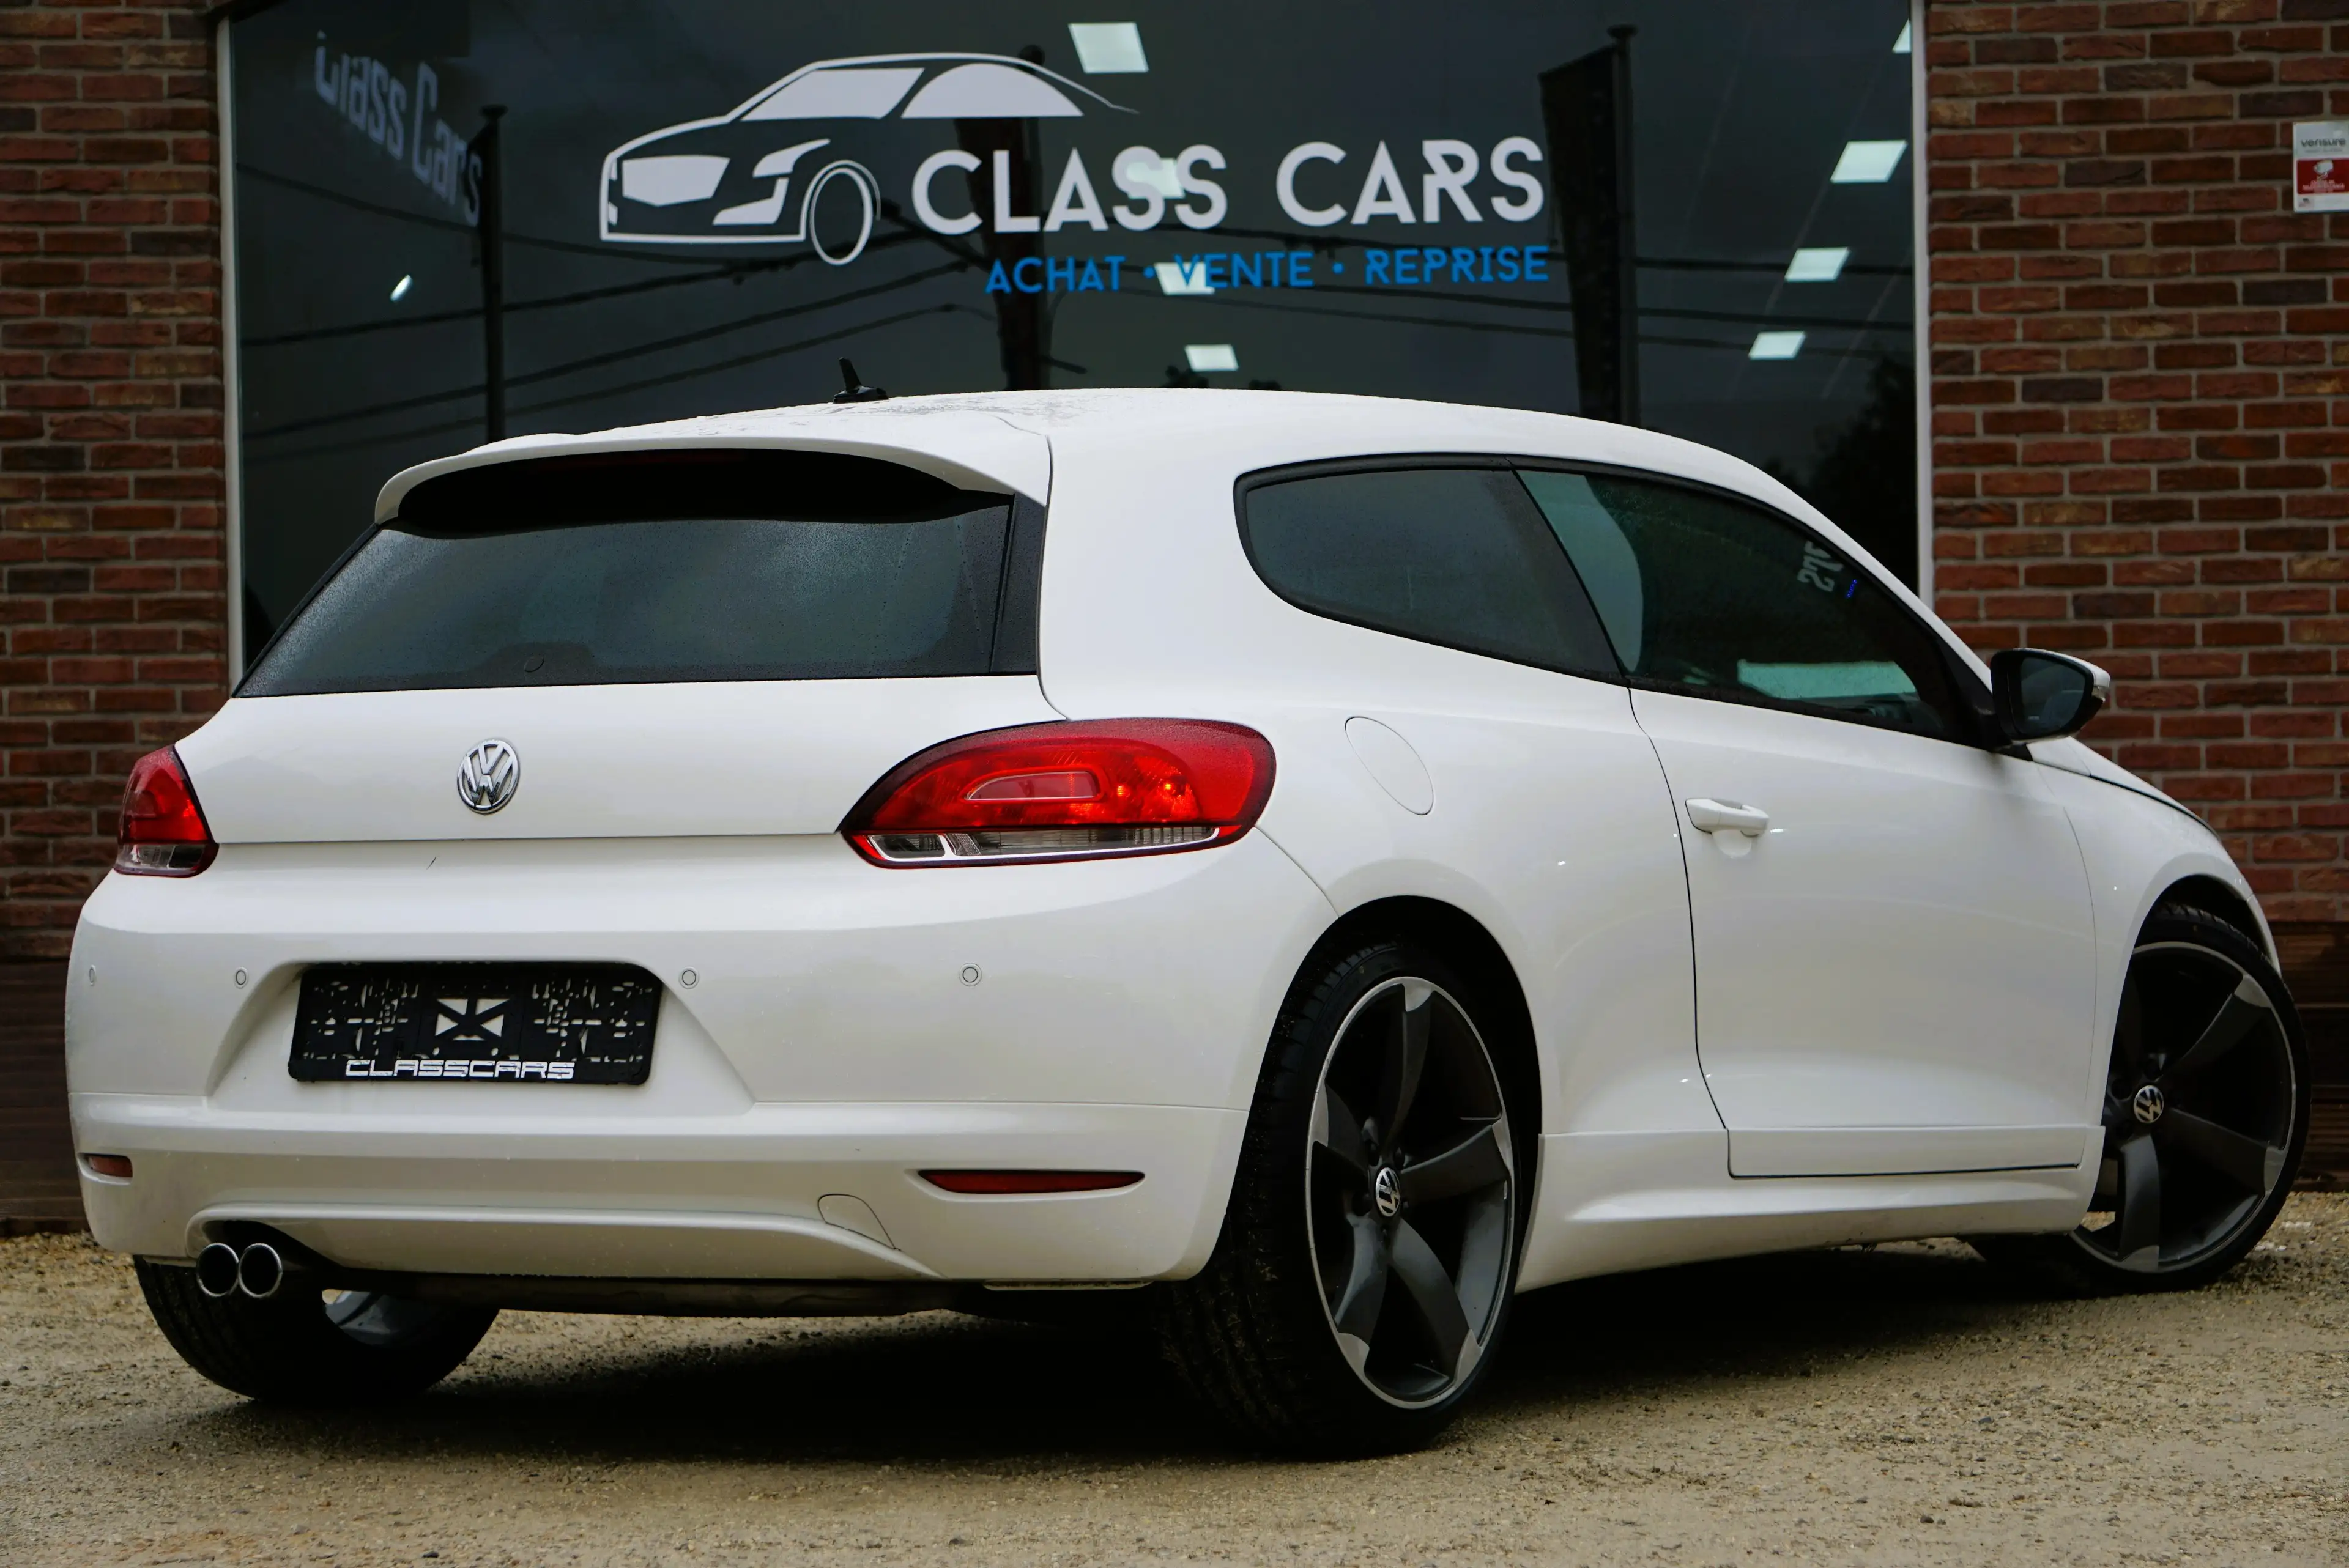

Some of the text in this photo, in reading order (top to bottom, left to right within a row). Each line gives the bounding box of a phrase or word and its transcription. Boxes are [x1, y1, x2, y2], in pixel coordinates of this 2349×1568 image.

[2301, 138, 2347, 147] verisure
[912, 136, 1544, 234] CLASS CARS
[984, 245, 1550, 295] ACHAT VENTE REPRISE
[346, 1056, 575, 1079] CLASSCARS
